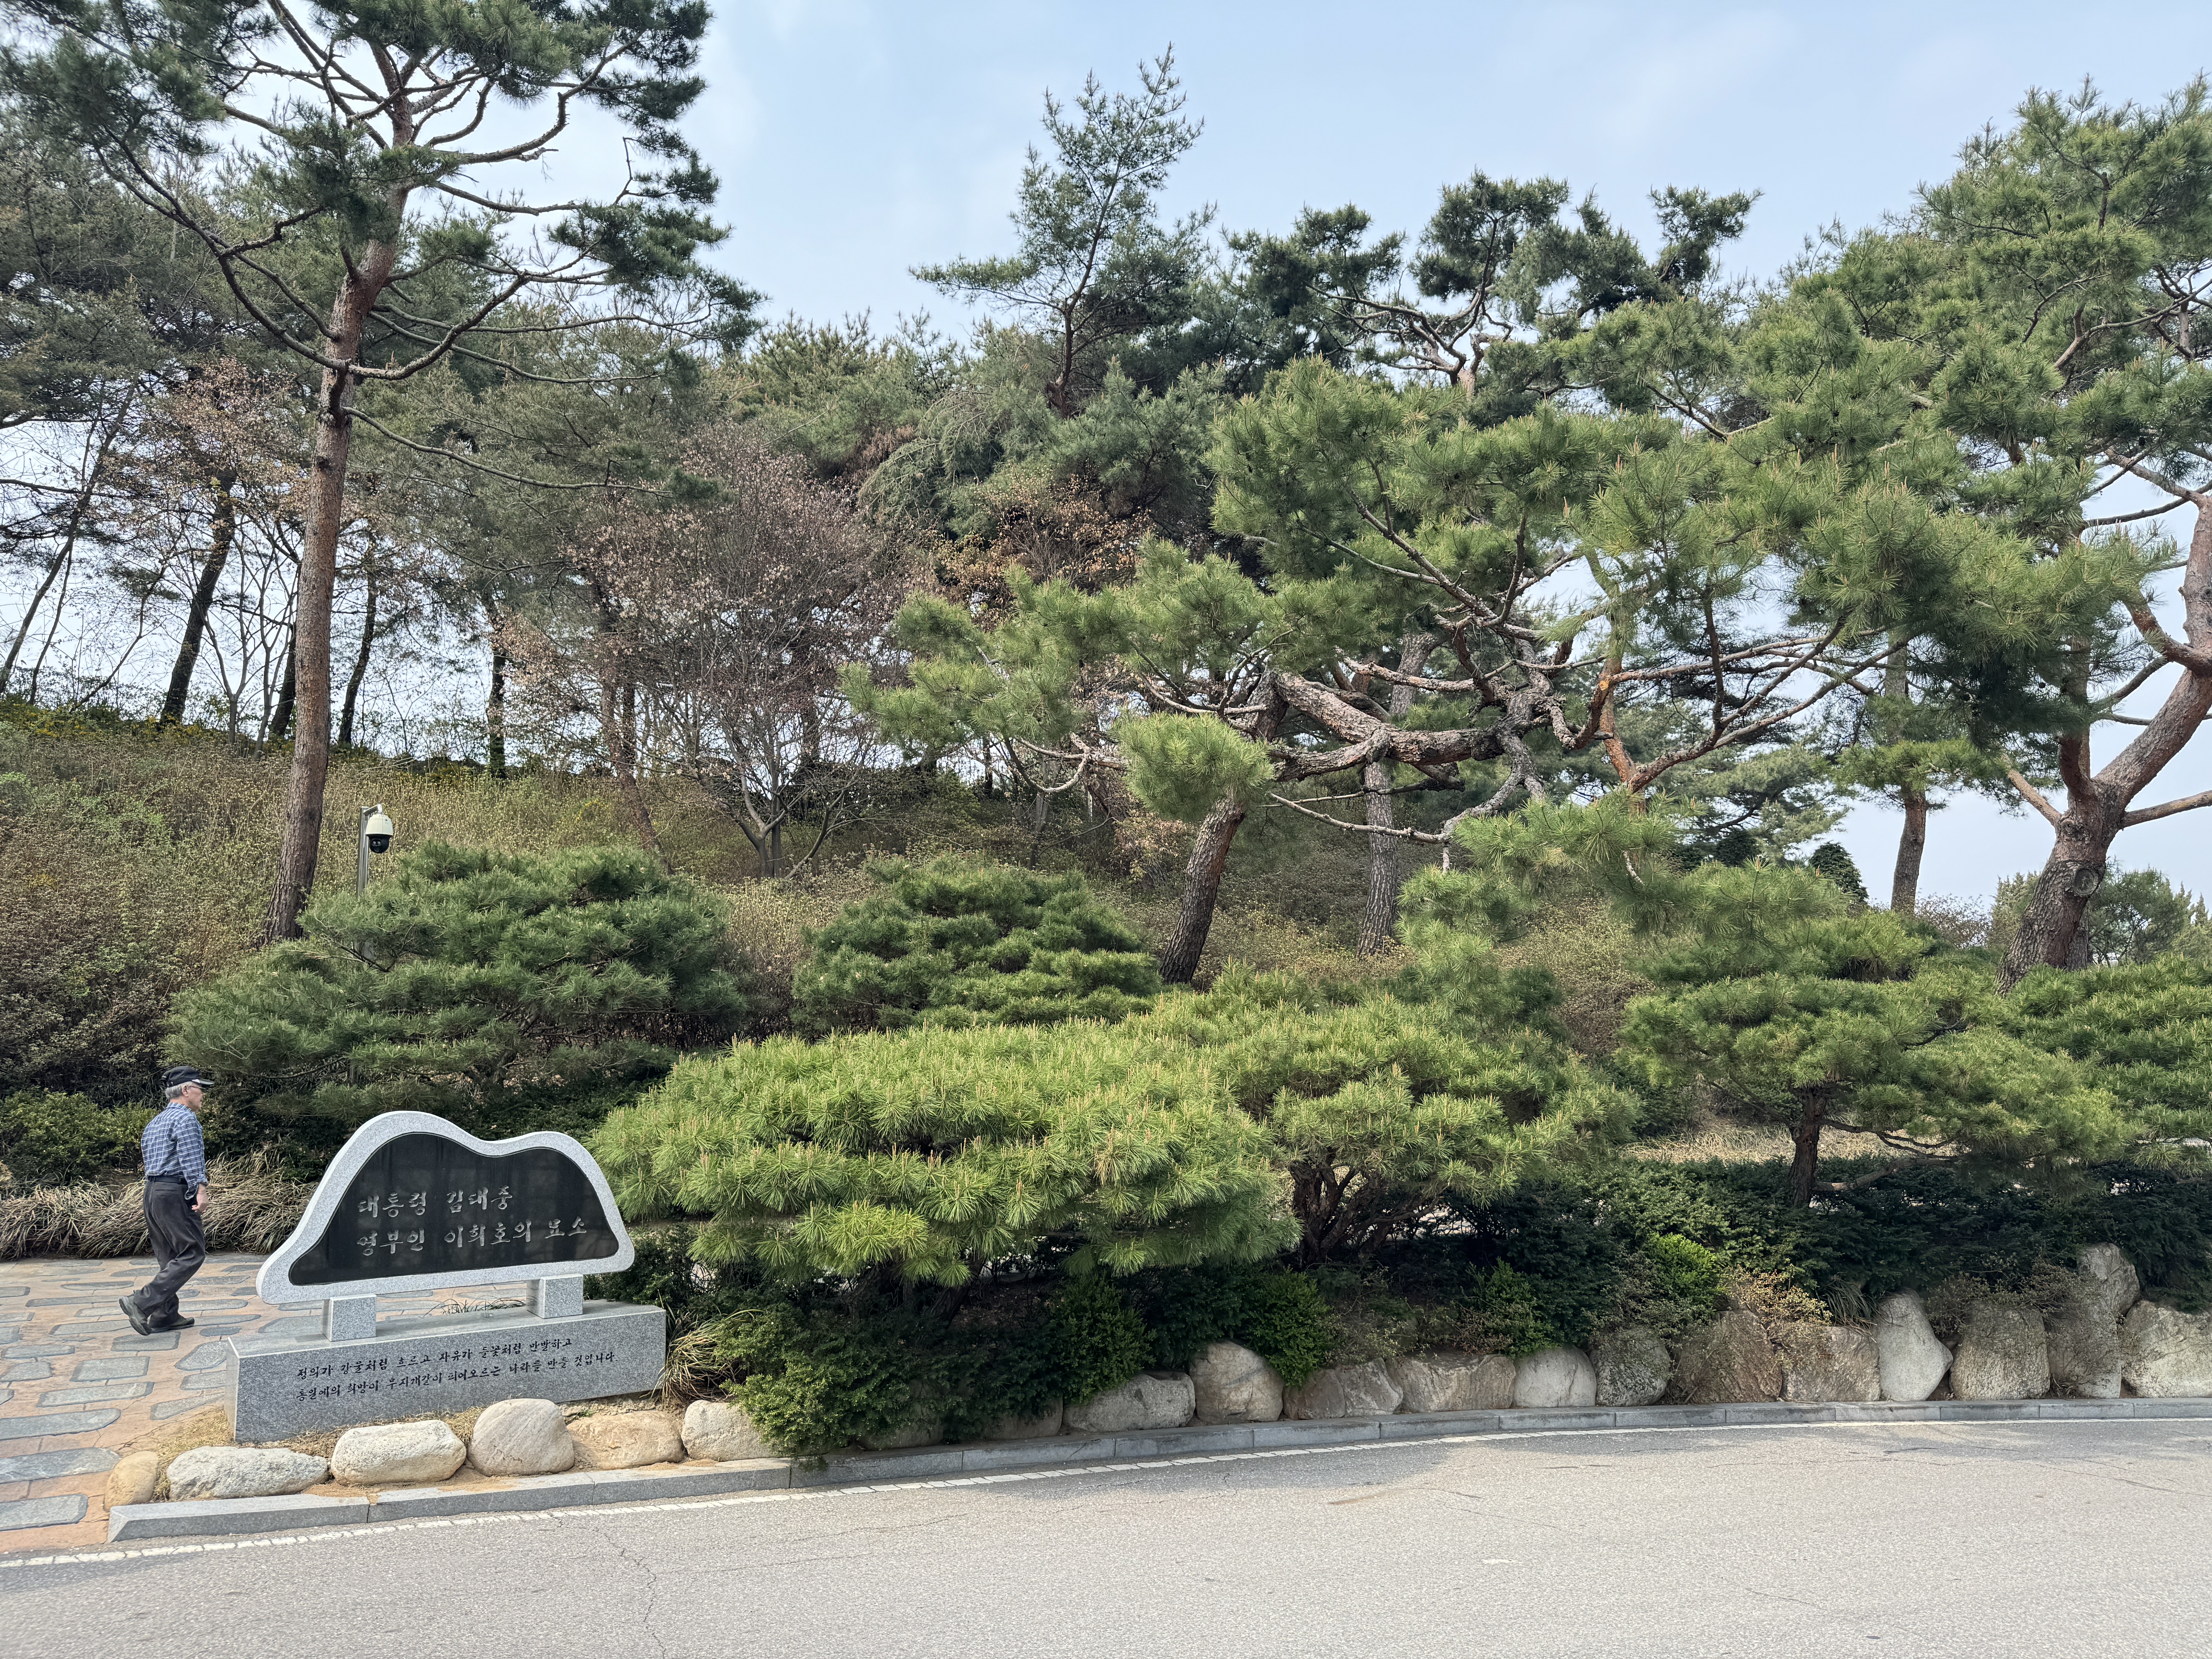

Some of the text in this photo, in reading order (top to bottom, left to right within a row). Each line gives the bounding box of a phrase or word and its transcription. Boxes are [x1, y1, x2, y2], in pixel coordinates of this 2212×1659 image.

[357, 1185, 513, 1218] 대통령 김대중
[356, 1216, 587, 1256] 영부인 이희호의 묘소
[296, 1351, 618, 1401] 통일에의 희망이 무지개같이 피어오르는 나라를 만들 것입니다.
[297, 1364, 334, 1380] 정의가
[396, 1355, 431, 1367] 흐르고
[439, 1348, 473, 1362] 자유가
[478, 1343, 521, 1358] 들꽃처럼
[529, 1338, 572, 1352] 만발하고
